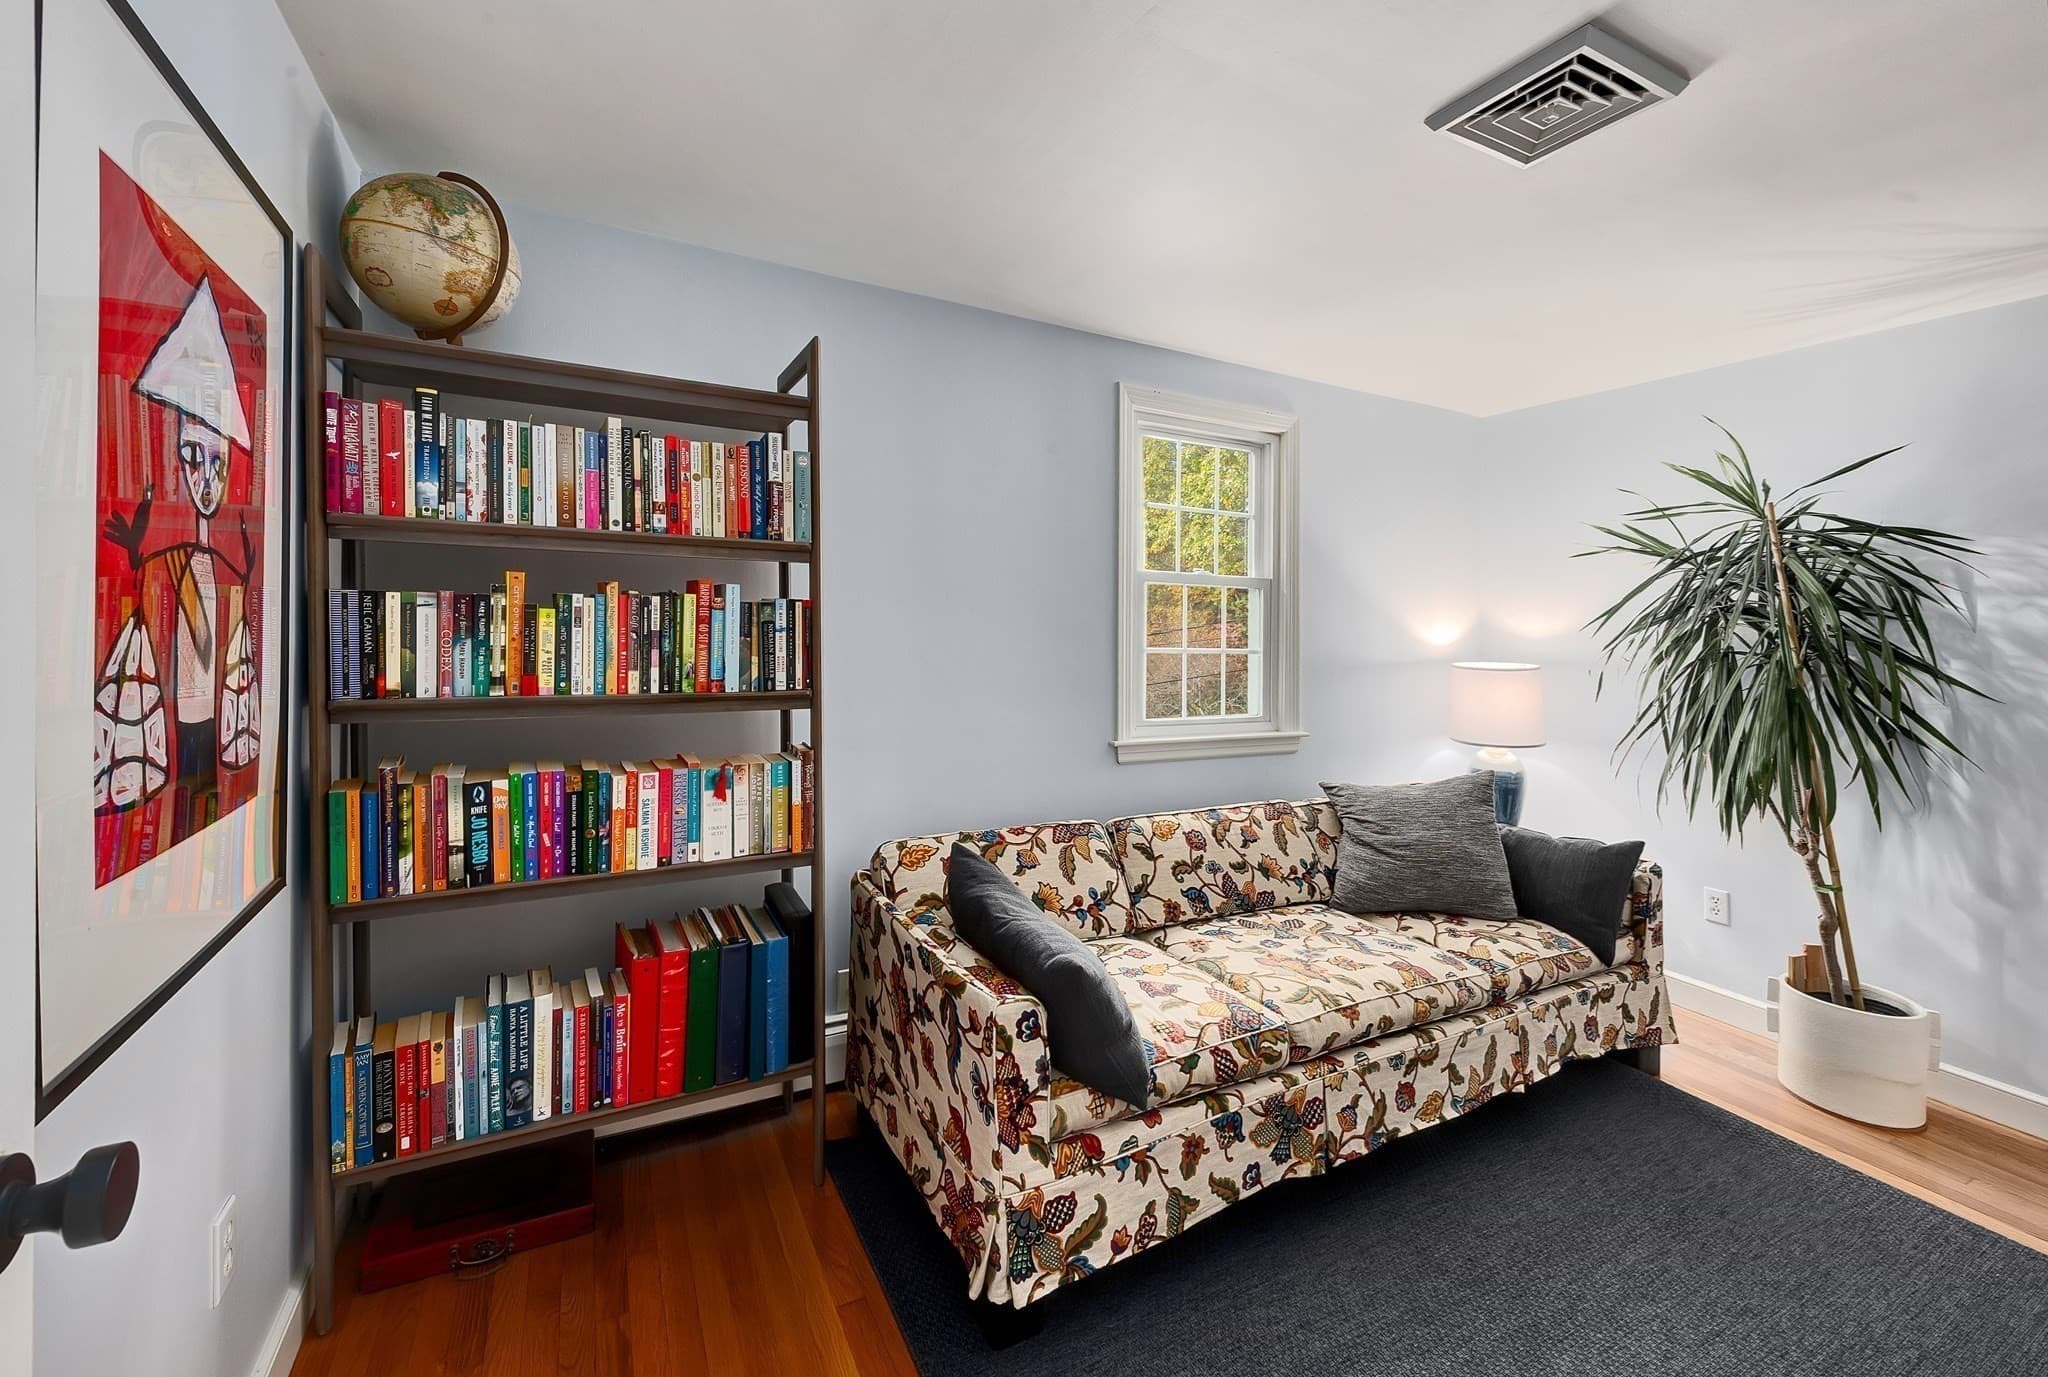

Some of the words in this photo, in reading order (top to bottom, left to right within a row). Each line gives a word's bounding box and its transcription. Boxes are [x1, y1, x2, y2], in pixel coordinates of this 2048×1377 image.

[421, 397, 432, 410] IAIN
[421, 413, 432, 421] M.
[422, 422, 432, 442] BANKS
[739, 448, 749, 498] BIRDSONG
[363, 595, 372, 615] NEIL
[700, 584, 709, 606] HARPER
[514, 607, 519, 617] OF
[700, 608, 709, 616] LEE
[364, 617, 372, 653] GAIMAN
[699, 624, 709, 632] GO
[699, 634, 709, 643] SET
[441, 630, 451, 672] CODEX
[698, 650, 708, 682] WATCHMAN
[470, 805, 488, 815] KNIFE
[641, 798, 650, 825] SALMAN
[471, 816, 486, 829] JO
[641, 829, 649, 858] RUSHDIE
[509, 1008, 517, 1030] HANYA
[616, 1002, 626, 1017] Me
[489, 1015, 499, 1038] French
[519, 1015, 528, 1047] LITTLE
[618, 1019, 624, 1027] vs
[466, 1030, 475, 1055] COLLEEN
[490, 1040, 500, 1063] Braid
[579, 1036, 587, 1058] SMITH
[616, 1028, 626, 1053] Brain
[466, 1056, 476, 1080] HOOVER
[520, 1049, 528, 1070] LIFE
[382, 1059, 392, 1087] DONNA
[490, 1067, 499, 1088] ANNE
[580, 1067, 585, 1077] ON
[383, 1089, 393, 1118] TARTT
[491, 1090, 501, 1112] TYLER
